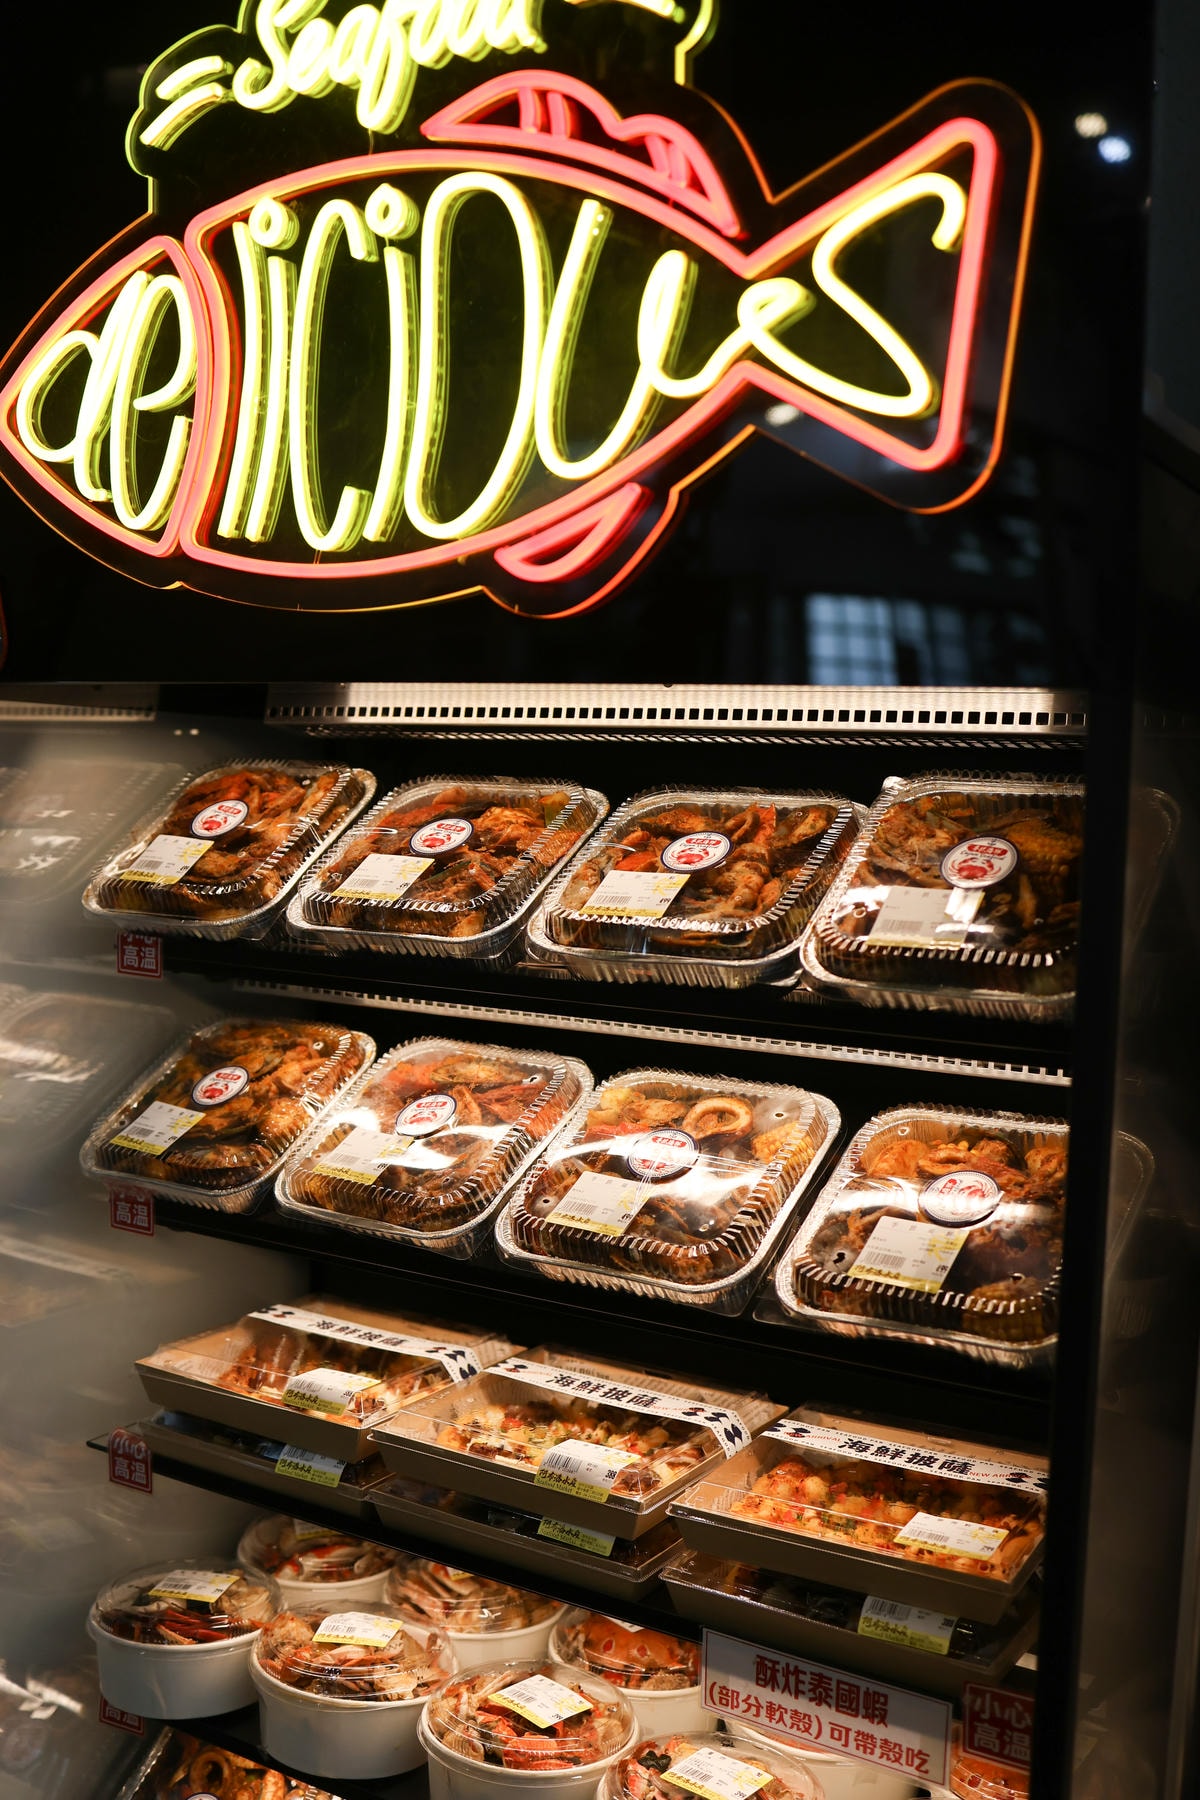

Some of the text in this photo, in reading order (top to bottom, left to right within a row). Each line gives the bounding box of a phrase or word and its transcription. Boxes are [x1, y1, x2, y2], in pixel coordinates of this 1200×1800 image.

[232, 0, 547, 133] Seafood
[545, 1373, 662, 1408] 海鮮披薩
[837, 1437, 976, 1476] 海鮮披薩
[755, 1653, 889, 1728] 酥炸泰國蝦
[974, 1692, 1034, 1729] 小心
